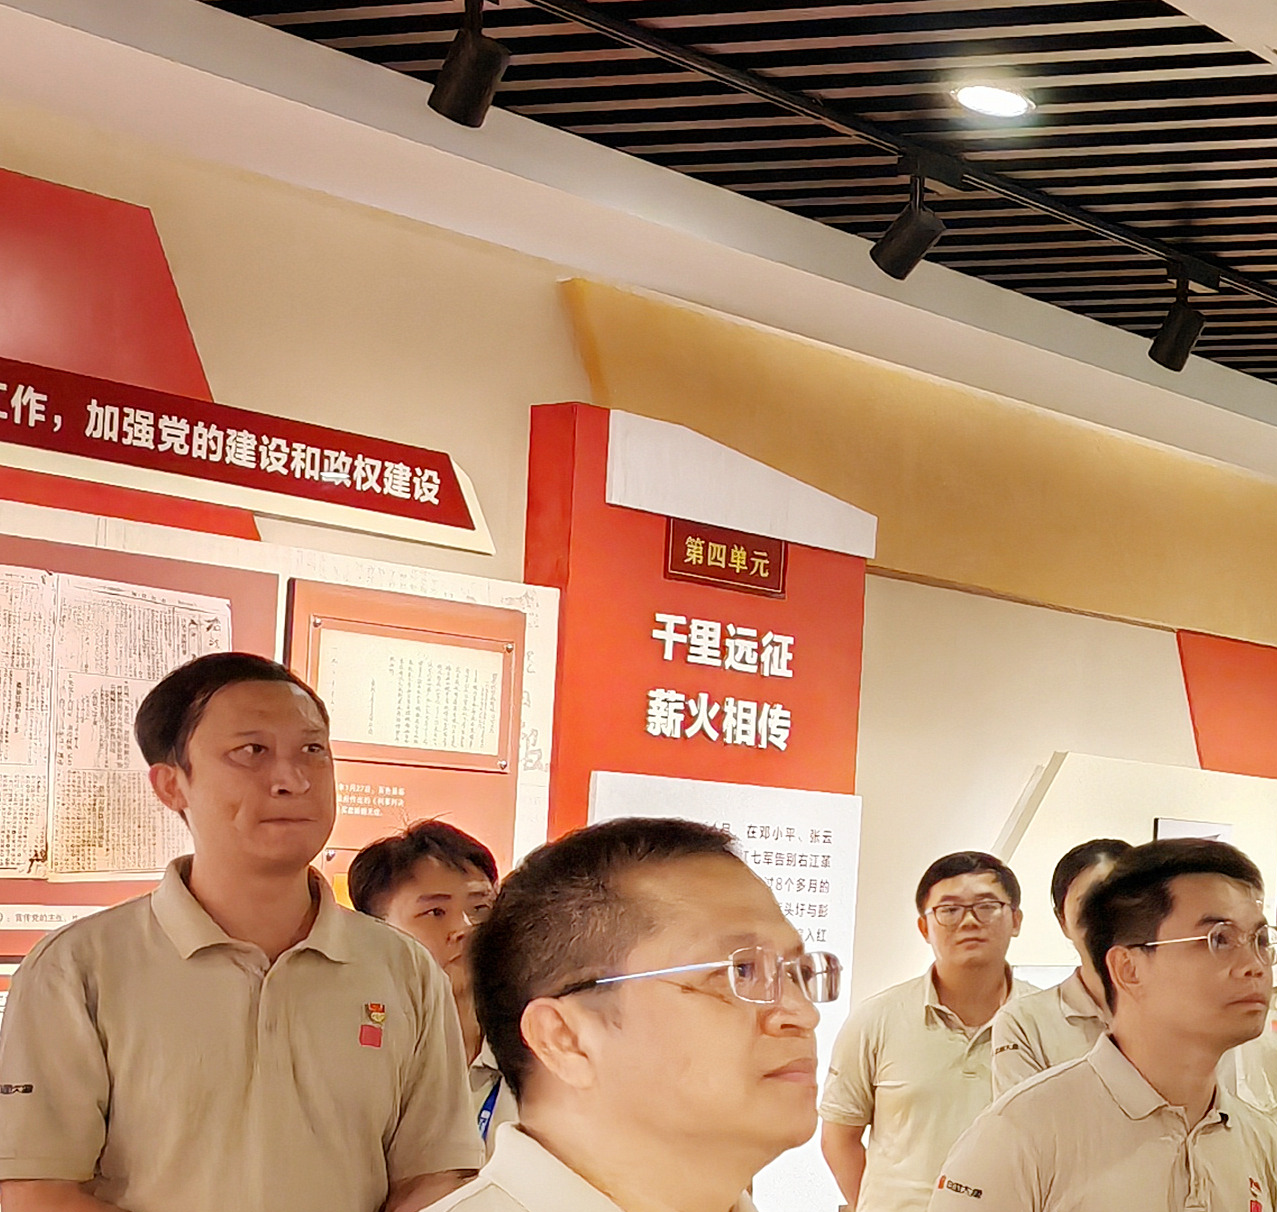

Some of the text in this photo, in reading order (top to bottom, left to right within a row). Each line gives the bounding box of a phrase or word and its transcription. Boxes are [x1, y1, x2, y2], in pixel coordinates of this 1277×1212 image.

[0, 383, 442, 505] 作，加强党的建设和政权建设
[684, 536, 770, 578] 第四单元
[652, 612, 795, 678] 千里远征
[645, 688, 792, 751] 薪火相传
[778, 902, 829, 918] 头圩与彭
[797, 927, 827, 942] 入红
